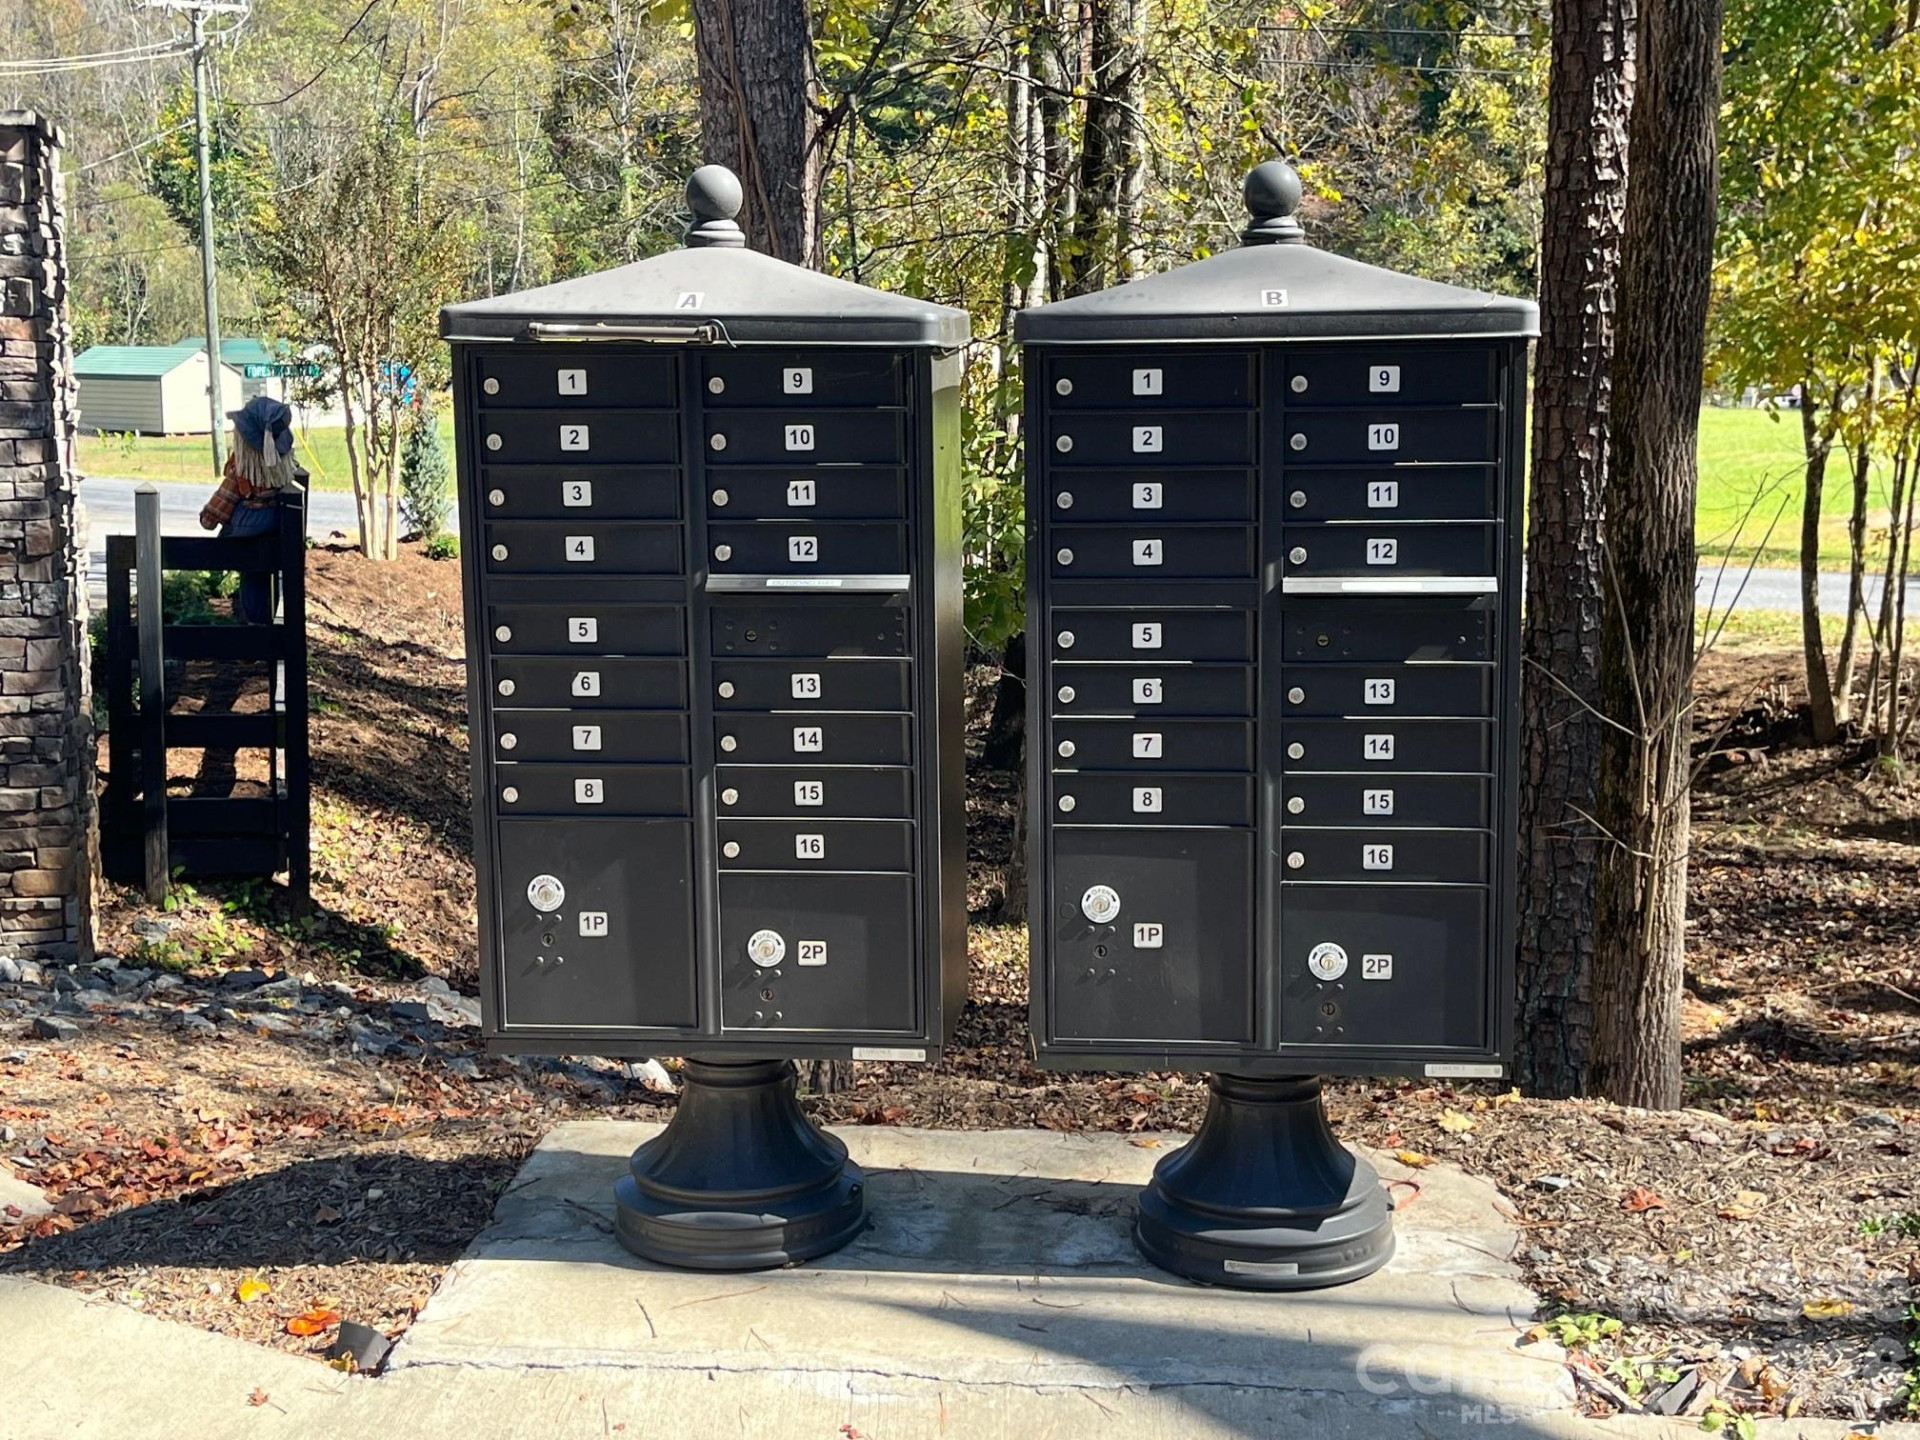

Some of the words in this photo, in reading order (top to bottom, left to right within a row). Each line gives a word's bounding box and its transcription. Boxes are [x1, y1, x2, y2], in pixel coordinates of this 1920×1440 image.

[680, 293, 697, 308] A
[1266, 291, 1283, 305] B
[567, 373, 576, 389] 1
[792, 372, 803, 388] 9
[1143, 372, 1151, 389] 1
[1379, 370, 1390, 387] 9
[569, 429, 580, 445] 2
[789, 429, 810, 445] 10
[1142, 430, 1153, 446] 2
[1373, 428, 1395, 444] 10
[572, 485, 582, 501] 3
[791, 484, 810, 500] 11
[1142, 486, 1153, 502] 3
[1372, 485, 1392, 502] 11
[574, 540, 585, 555] 4
[793, 540, 814, 556] 12
[1142, 543, 1153, 559] 4
[1371, 543, 1393, 559] 12
[579, 622, 588, 637] 5
[1142, 627, 1152, 642] 5
[581, 676, 591, 691] 6
[796, 678, 817, 693] 13
[1142, 682, 1153, 698] 6
[1369, 683, 1390, 699] 13
[582, 730, 592, 744] 7
[798, 731, 819, 746] 14
[1142, 737, 1153, 752] 7
[1369, 739, 1390, 754] 14
[584, 783, 594, 798] 8
[799, 785, 819, 800] 15
[1142, 791, 1153, 807] 8
[1368, 794, 1390, 809] 15
[800, 839, 820, 853] 16
[1368, 849, 1389, 864] 16
[535, 876, 557, 885] OPEN
[1090, 887, 1112, 897] OPEN
[583, 915, 605, 931] 1P
[756, 932, 776, 941] OPEN
[1137, 926, 1160, 942] 1P
[801, 944, 824, 960] 2P
[1317, 944, 1340, 954] OPEN
[1366, 959, 1389, 973] 2P
